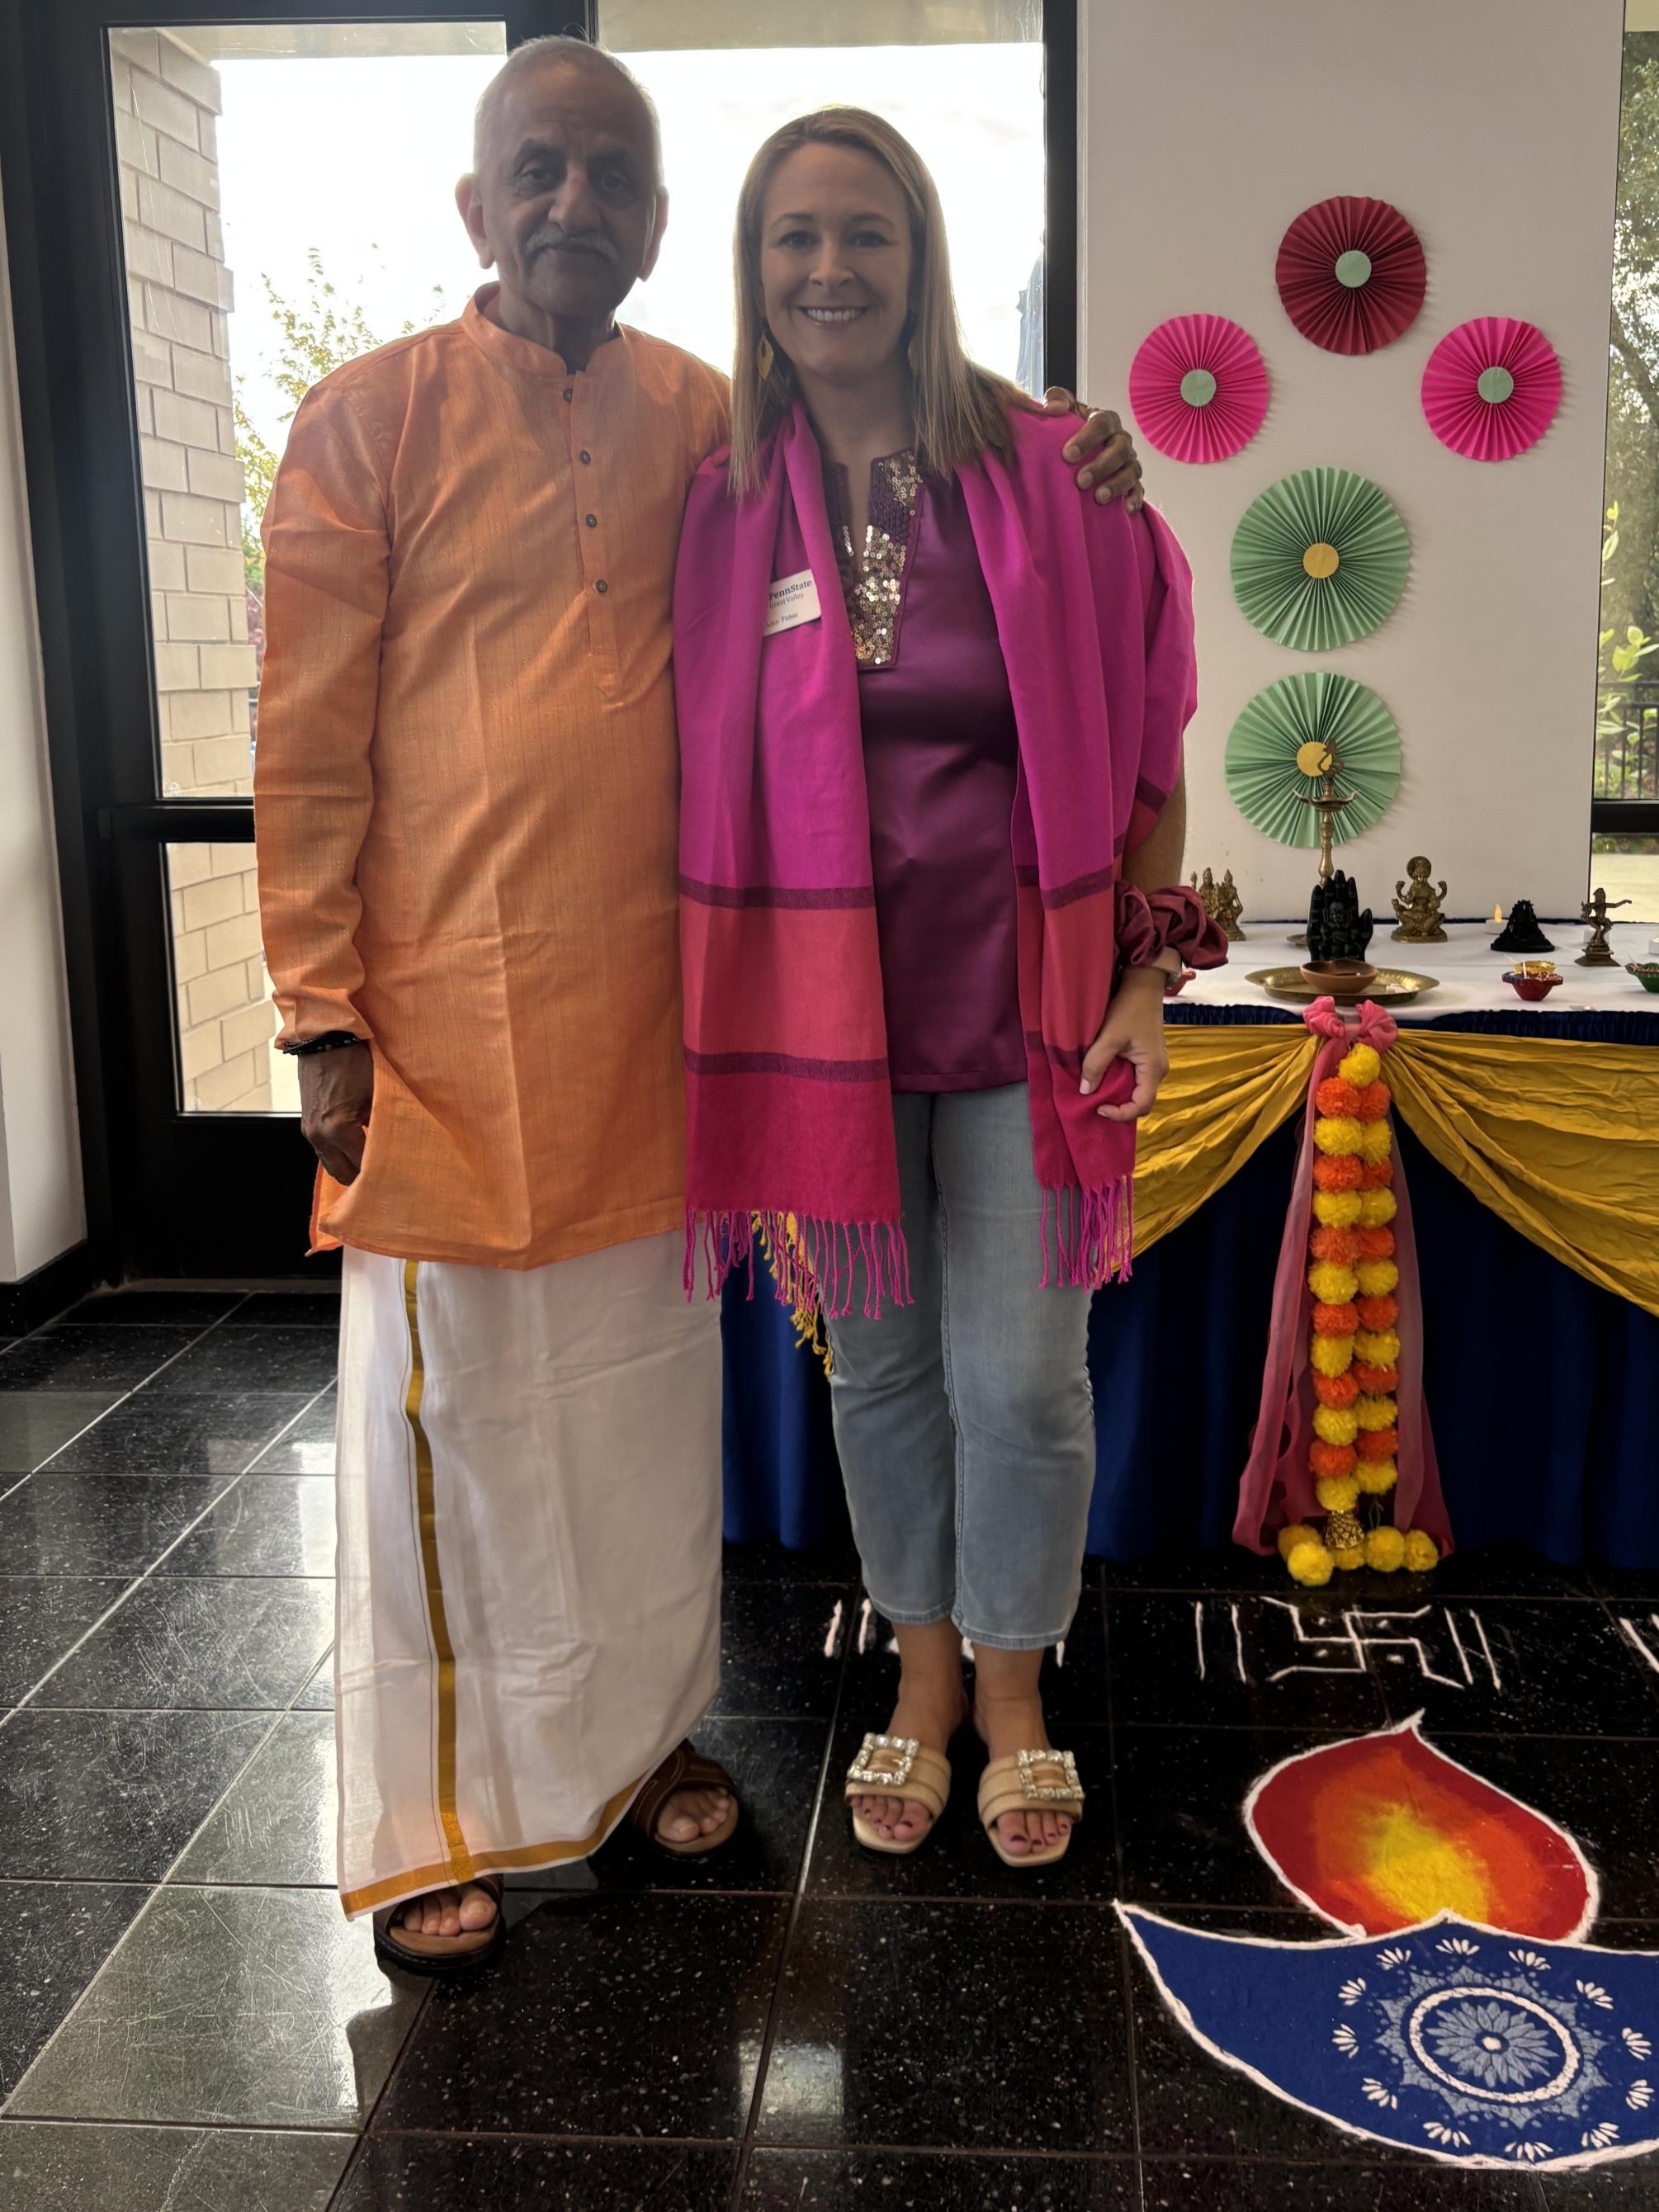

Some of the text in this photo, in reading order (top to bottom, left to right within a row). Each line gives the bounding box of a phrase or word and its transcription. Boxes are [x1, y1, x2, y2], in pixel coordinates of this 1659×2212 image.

[768, 580, 812, 600] PennState
[769, 593, 805, 608] Great Valley
